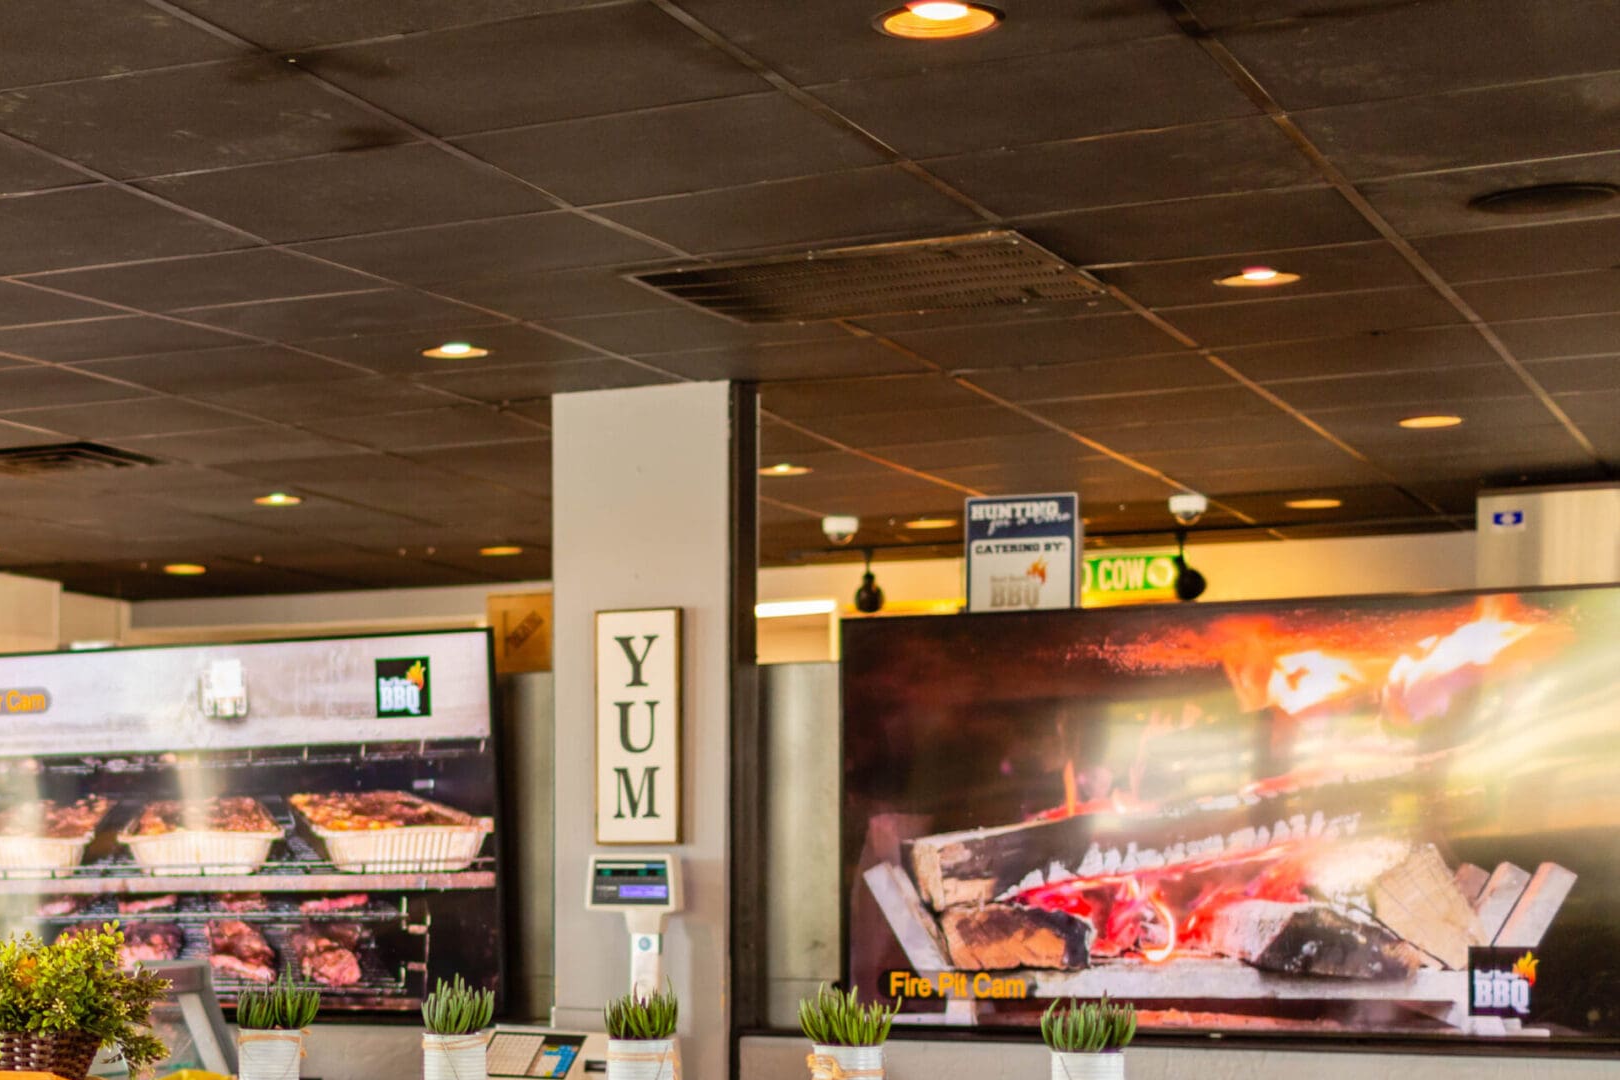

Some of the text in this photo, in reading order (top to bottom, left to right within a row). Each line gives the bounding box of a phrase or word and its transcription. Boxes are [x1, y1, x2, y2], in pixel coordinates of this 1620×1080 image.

[971, 501, 1059, 521] HUNTING
[975, 542, 1040, 555] CATERING
[1098, 557, 1145, 590] COW
[6, 689, 46, 712] Cam
[380, 685, 421, 714] BBQ
[613, 634, 660, 819] YUM
[890, 971, 1027, 998] Fire Pit Cam
[1474, 979, 1530, 1013] BBQ
